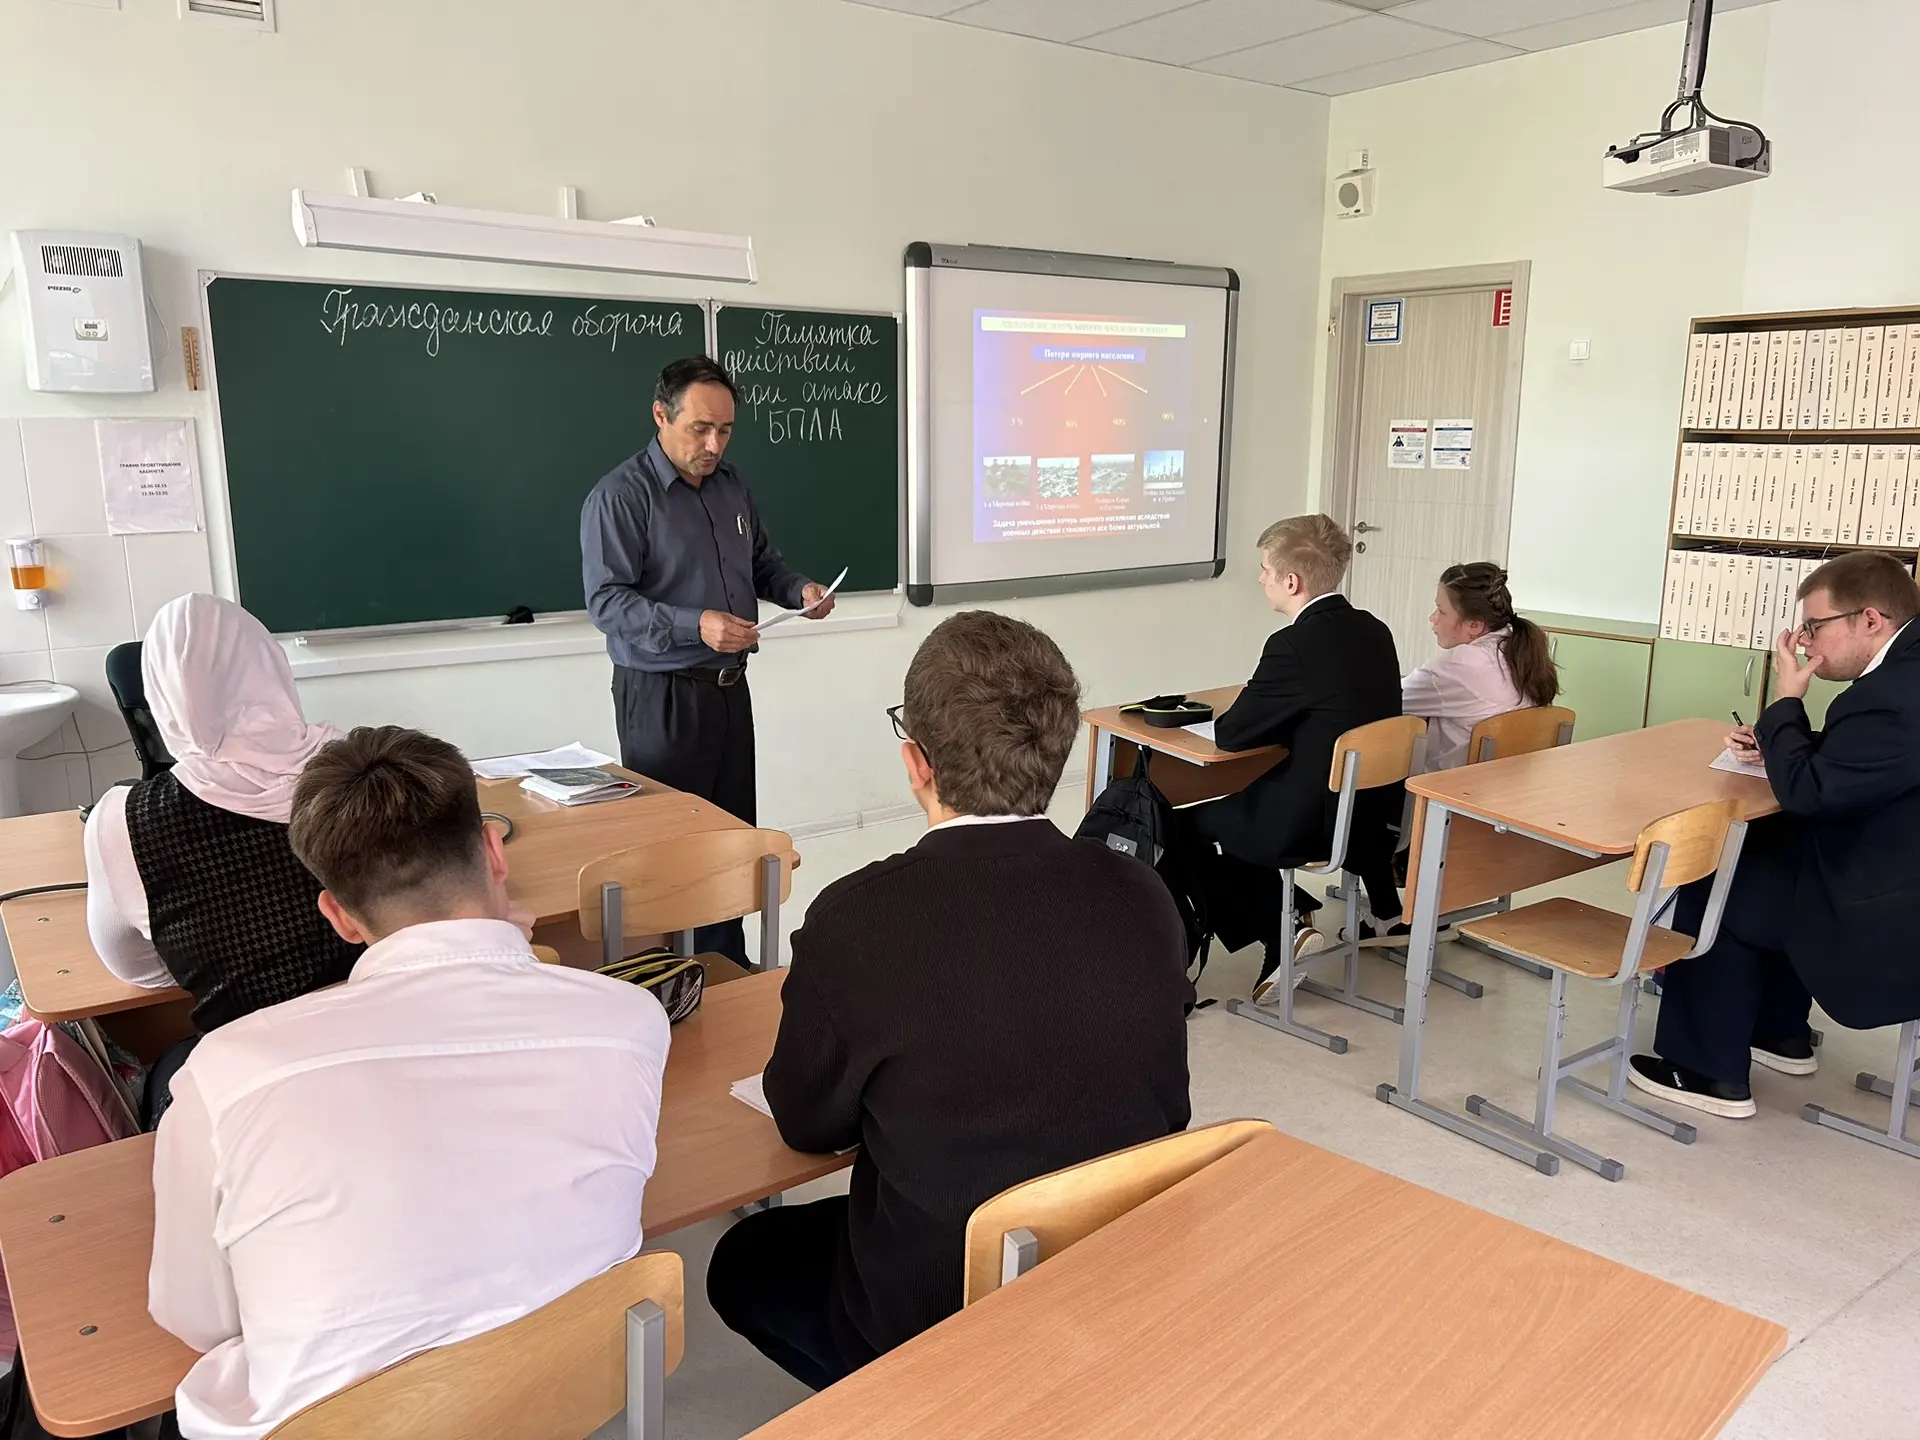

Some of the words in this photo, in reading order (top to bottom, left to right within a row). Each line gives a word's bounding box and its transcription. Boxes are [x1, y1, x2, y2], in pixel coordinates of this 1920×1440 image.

[320, 288, 553, 357] Гражданская
[572, 304, 684, 352] оборона
[755, 312, 880, 346] Памятка
[724, 344, 856, 384] действий
[1044, 348, 1070, 359] Потери
[1072, 350, 1100, 360] мирного
[802, 380, 888, 404] атаке
[768, 407, 843, 444] БПЛА
[992, 519, 1015, 528] Задача
[1057, 517, 1078, 525] потерь
[1106, 514, 1136, 522] населения
[1137, 512, 1170, 521] вследствие
[1109, 524, 1126, 532] более
